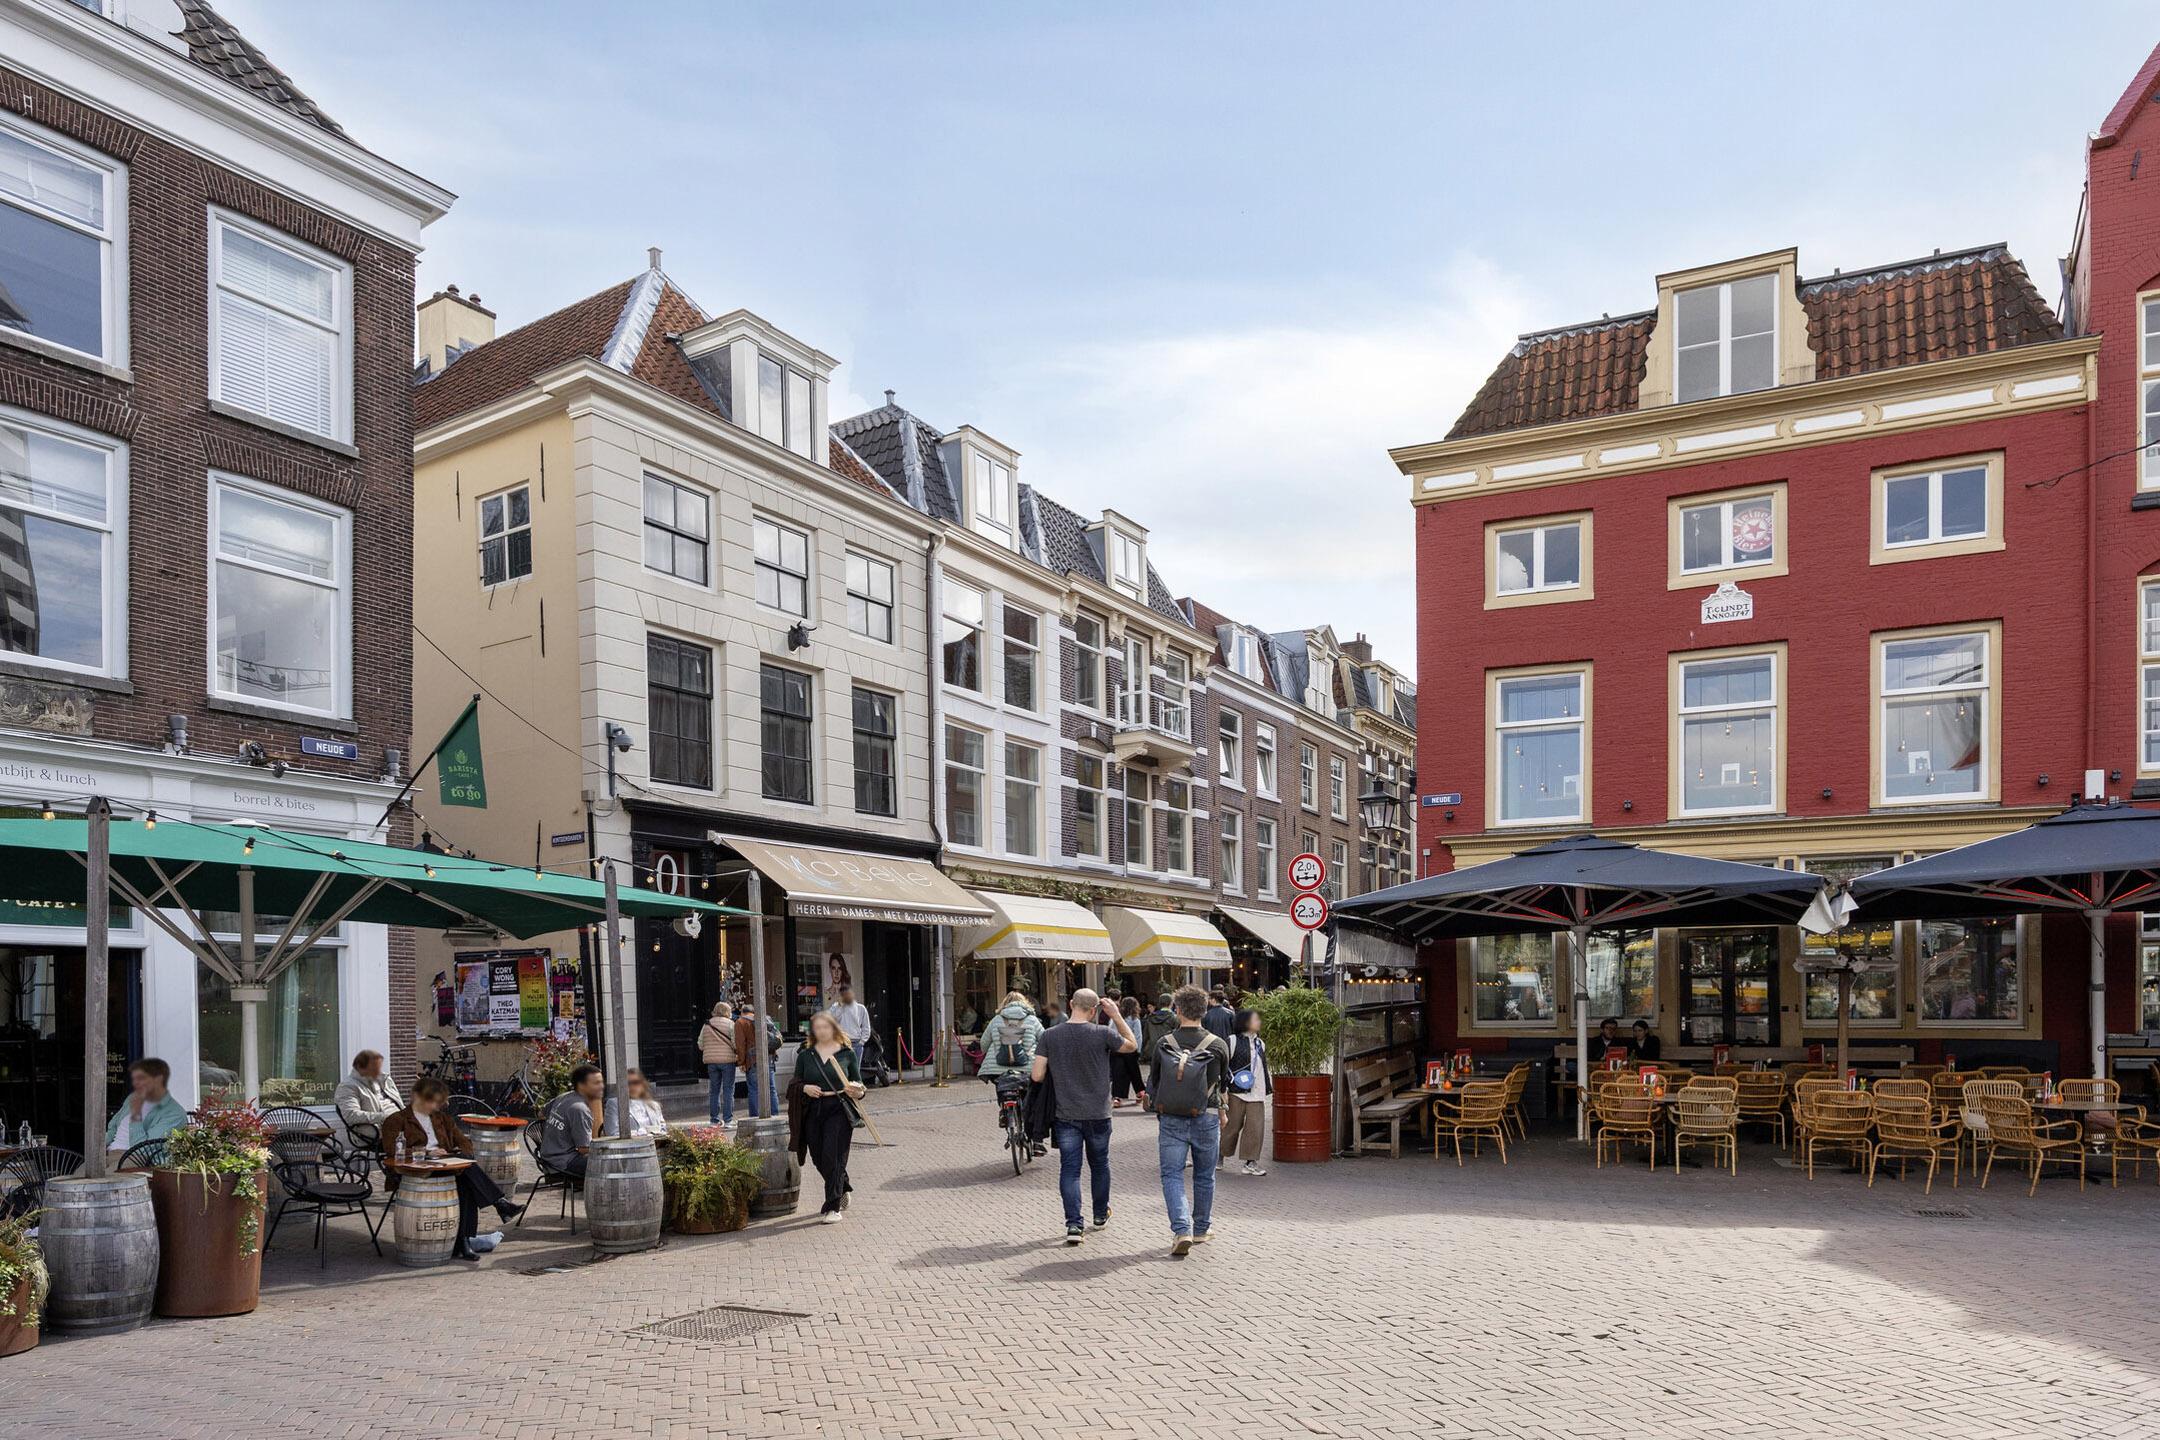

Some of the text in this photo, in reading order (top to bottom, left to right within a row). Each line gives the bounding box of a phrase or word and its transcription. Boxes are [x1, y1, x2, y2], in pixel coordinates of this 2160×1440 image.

[316, 743, 344, 755] NEUDE
[40, 768, 51, 781] &
[56, 770, 96, 786] lunch
[233, 792, 316, 811] borrel & bites
[1431, 796, 1452, 804] NEUDE
[840, 860, 932, 888] Belle
[796, 903, 992, 926] HEREN DAMES MET & ZONDER AFSPRAAK
[495, 966, 513, 974] CORY
[494, 973, 515, 982] WONG
[497, 1000, 514, 1008] THEO
[491, 1007, 520, 1015] KATZMAN
[304, 1082, 335, 1092] taart
